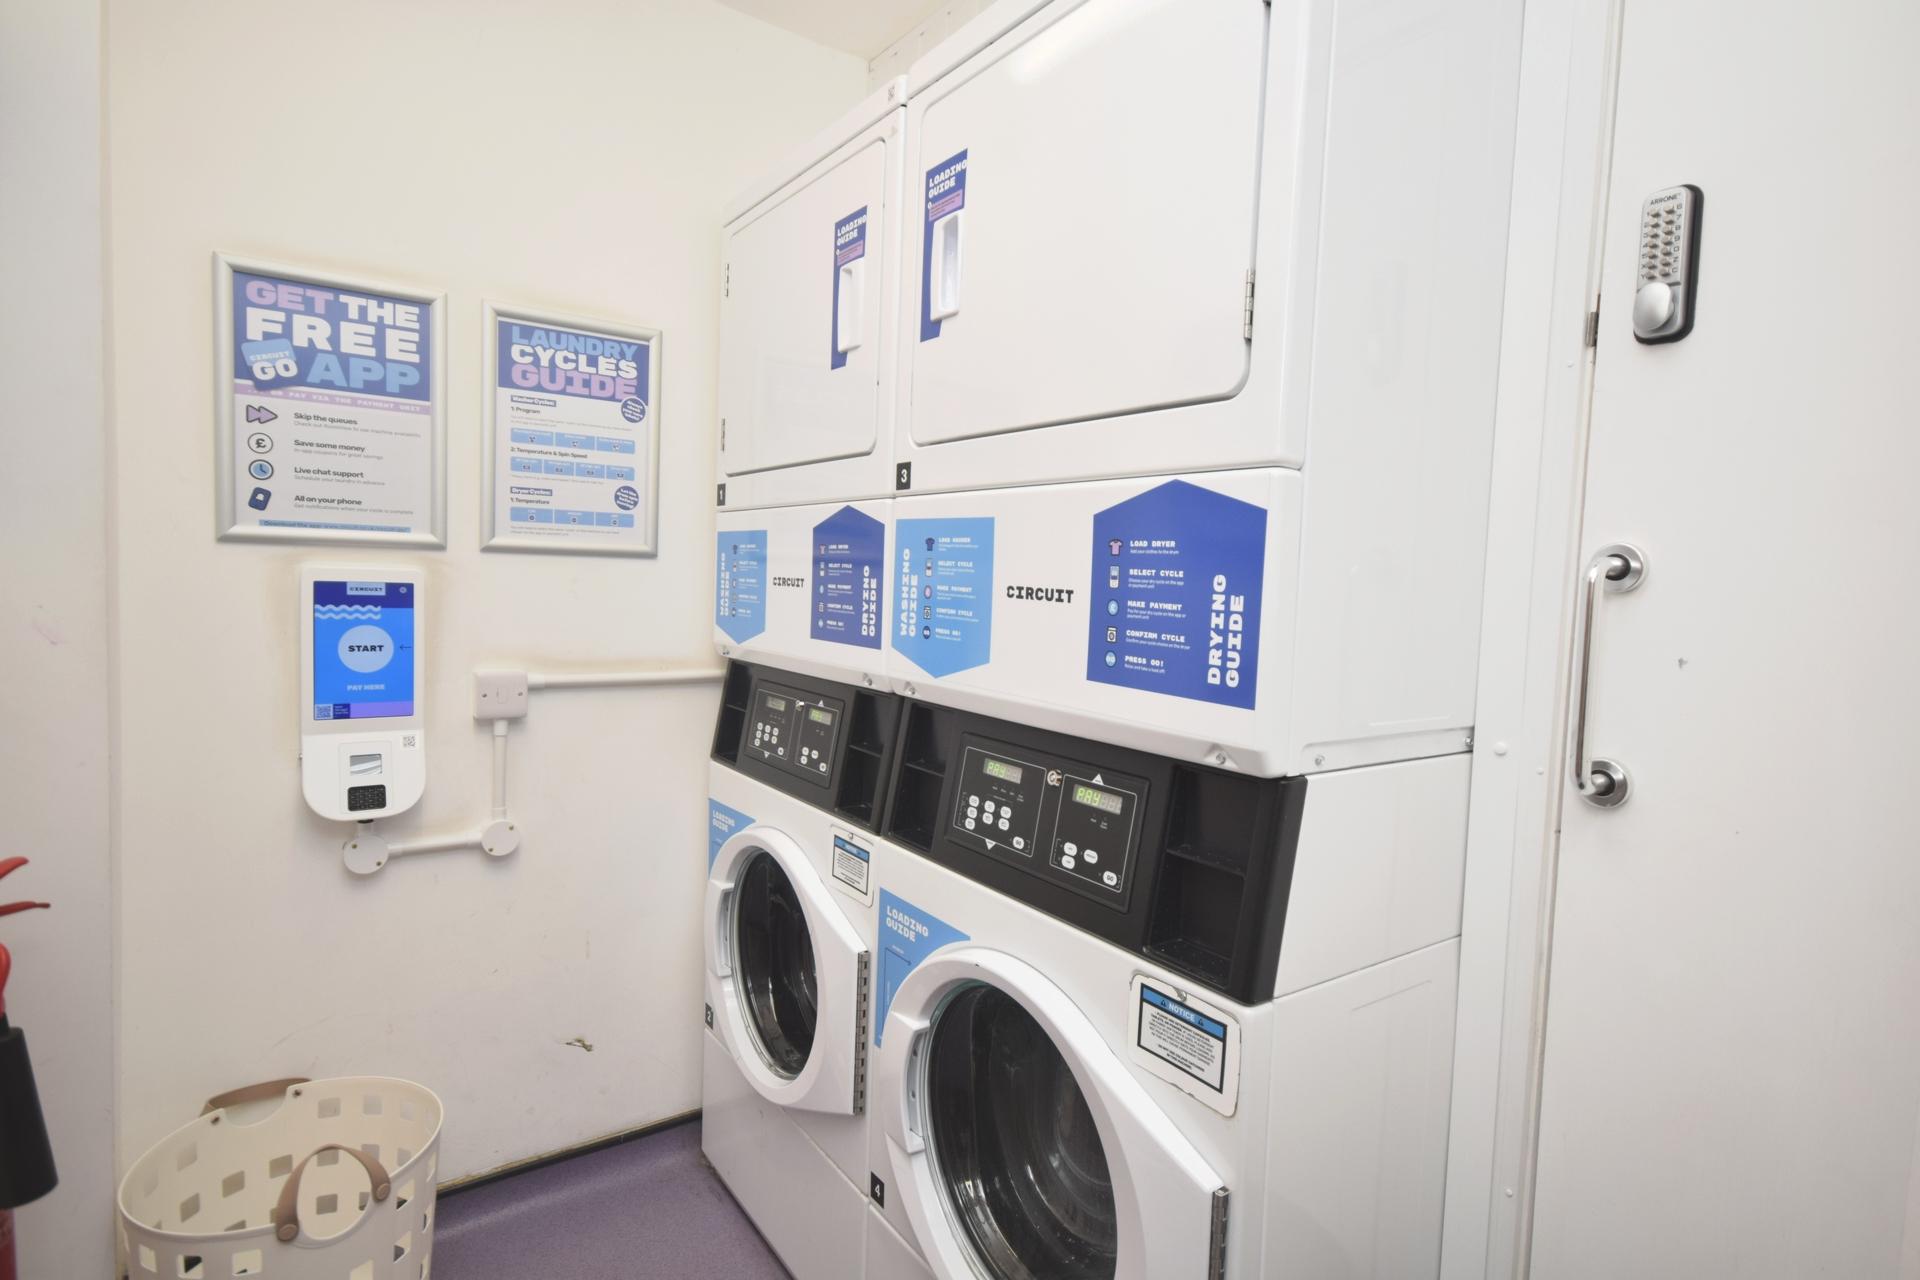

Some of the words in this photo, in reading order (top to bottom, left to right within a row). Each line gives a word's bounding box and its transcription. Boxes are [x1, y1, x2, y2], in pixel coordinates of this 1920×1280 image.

[929, 159, 967, 187] LOADING
[928, 177, 956, 198] GUIDE
[837, 214, 867, 237] LOADING
[837, 228, 858, 246] GUIDE
[246, 280, 333, 314] GET
[339, 294, 420, 330] THE
[246, 306, 420, 363] FREE
[512, 325, 638, 361] LAUNDRY
[252, 358, 298, 381] GO
[511, 344, 638, 379] CYCLES
[306, 352, 420, 393] APP
[511, 363, 638, 400] GUIDE
[312, 393, 328, 401] VIA
[357, 399, 395, 409] PAYMENT
[516, 406, 541, 414] Program
[293, 412, 312, 421] Skip
[328, 417, 358, 425] queues
[294, 439, 314, 447] Save
[338, 445, 365, 453] money
[517, 447, 552, 455] Temperature
[332, 470, 364, 478] support
[901, 469, 907, 483] 3
[1151, 540, 1176, 548] DRYER
[773, 576, 804, 588] CIRCUIT
[861, 565, 870, 636] DRYING
[900, 548, 910, 637] WASHING
[1006, 585, 1074, 603] CIRCUIT
[869, 578, 877, 637] GUIDE
[908, 574, 918, 637] GUIDE
[1127, 600, 1146, 608] MAKE
[1149, 602, 1182, 611] PAYMENT
[1126, 630, 1158, 639] CONFIRM
[1161, 634, 1185, 643] CYCLE
[1207, 574, 1227, 685] DRYING
[348, 644, 384, 653] START
[1225, 594, 1244, 688] GUIDE
[1125, 655, 1147, 664] PRESS
[1151, 659, 1164, 667] GO!
[987, 761, 1006, 777] PAY
[1076, 787, 1101, 805] PAY
[886, 905, 929, 937] LOADING
[886, 917, 916, 942] GUIDE
[707, 1012, 712, 1022] 2
[1168, 1002, 1196, 1023] NOTICE
[874, 1184, 881, 1198] 4
